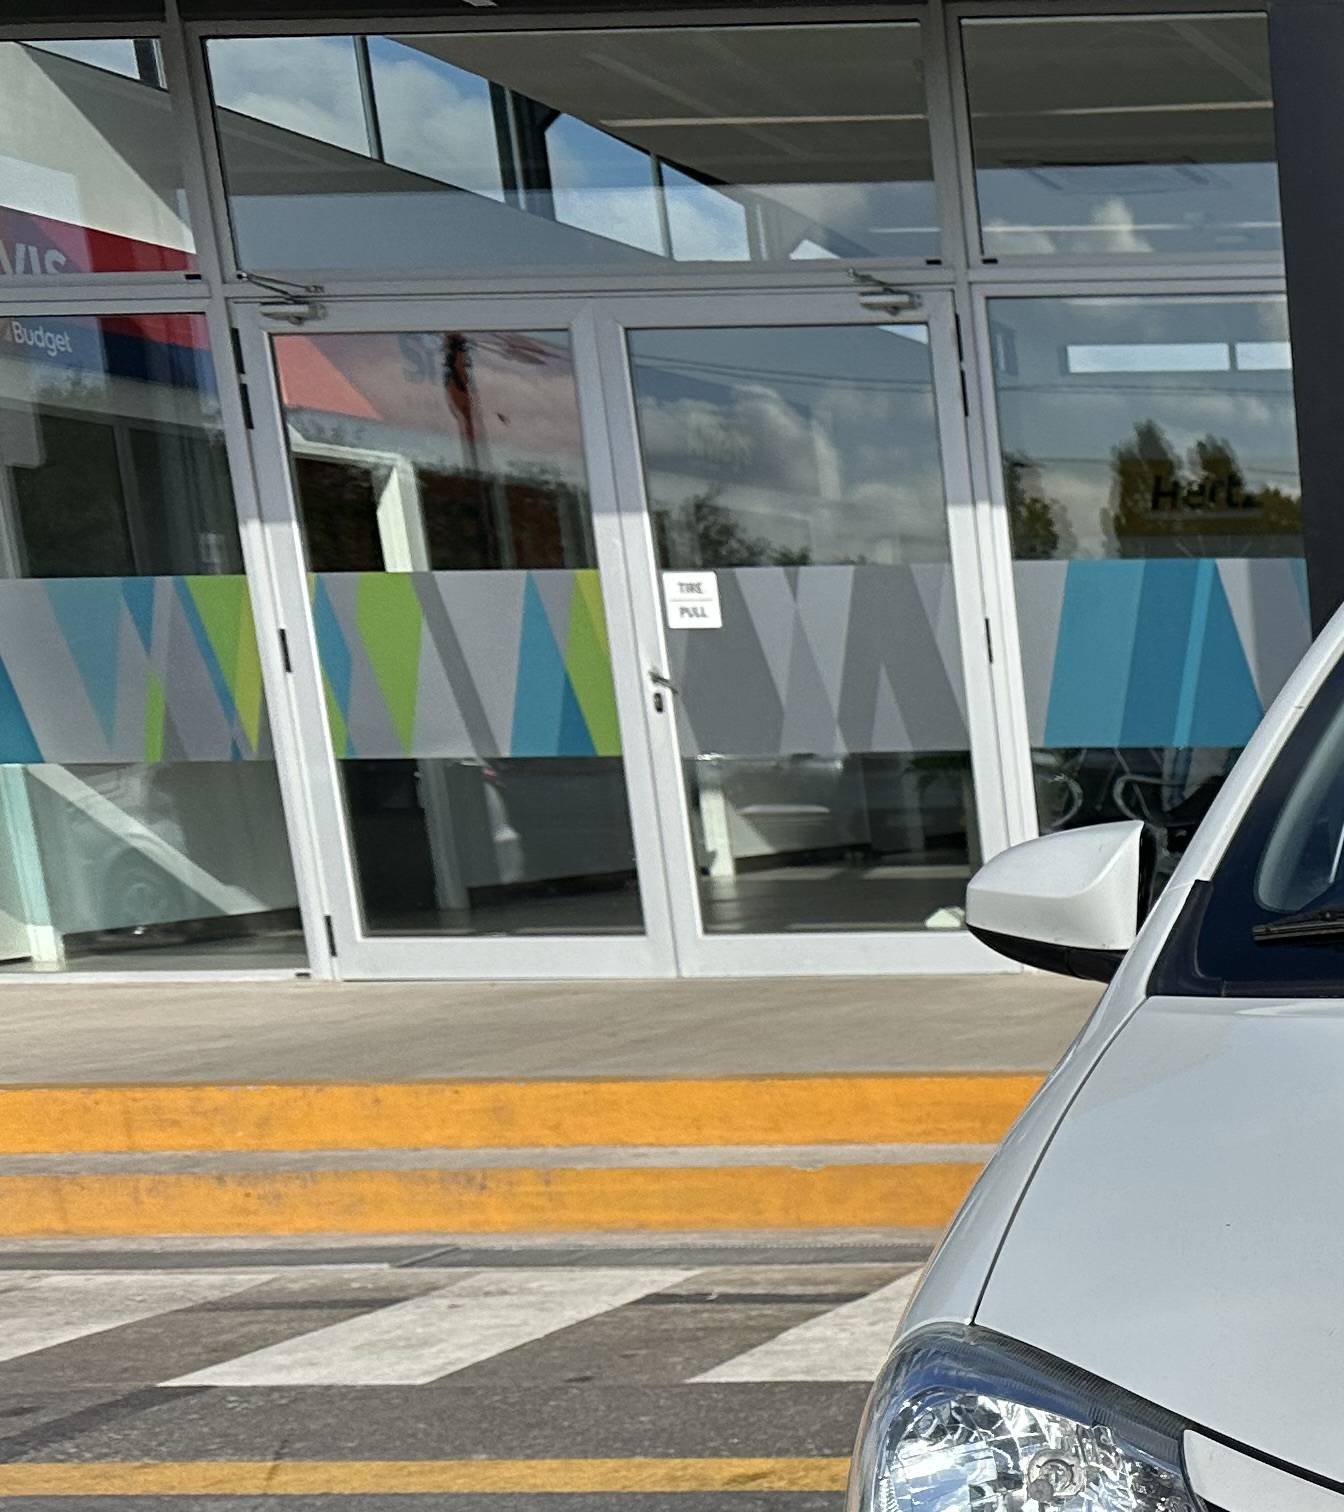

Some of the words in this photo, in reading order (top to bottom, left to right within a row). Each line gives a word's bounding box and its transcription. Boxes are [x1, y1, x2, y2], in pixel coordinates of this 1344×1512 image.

[11, 320, 73, 357] Budget
[677, 581, 705, 595] TIRE
[679, 606, 708, 619] PULL
